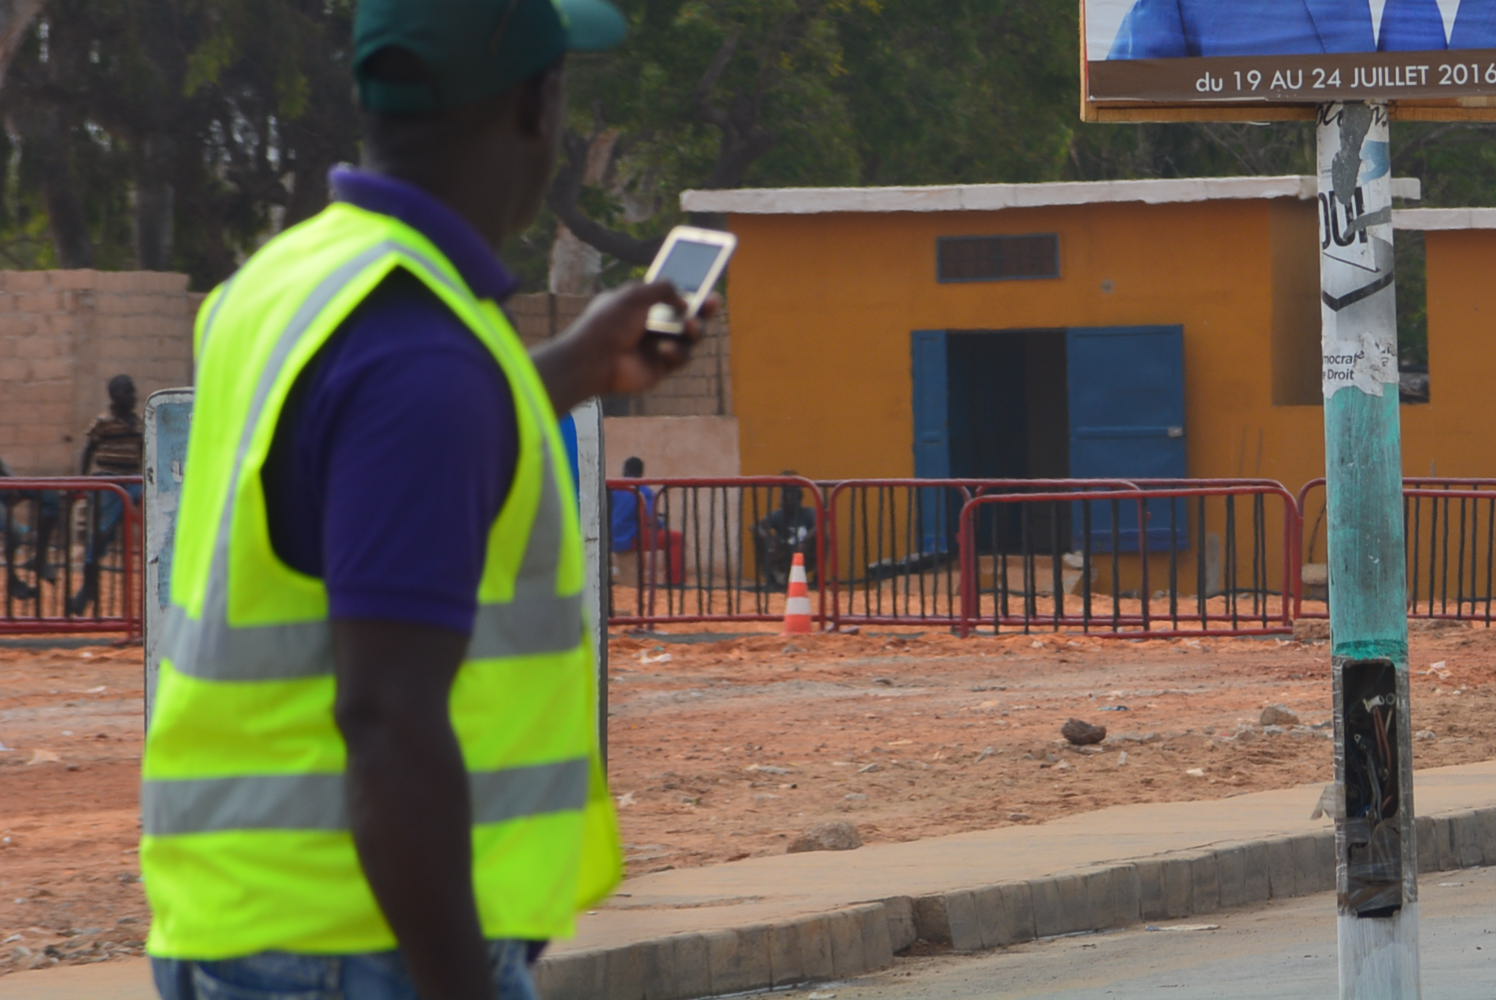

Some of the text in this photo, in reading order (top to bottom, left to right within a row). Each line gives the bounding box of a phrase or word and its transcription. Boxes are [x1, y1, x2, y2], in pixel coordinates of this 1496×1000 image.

[1195, 71, 1223, 92] du
[1233, 70, 1262, 91] 19
[1270, 69, 1303, 90] AU
[1311, 67, 1342, 89] 24
[1350, 65, 1430, 88] JUILLET
[1327, 368, 1355, 380] Droit
